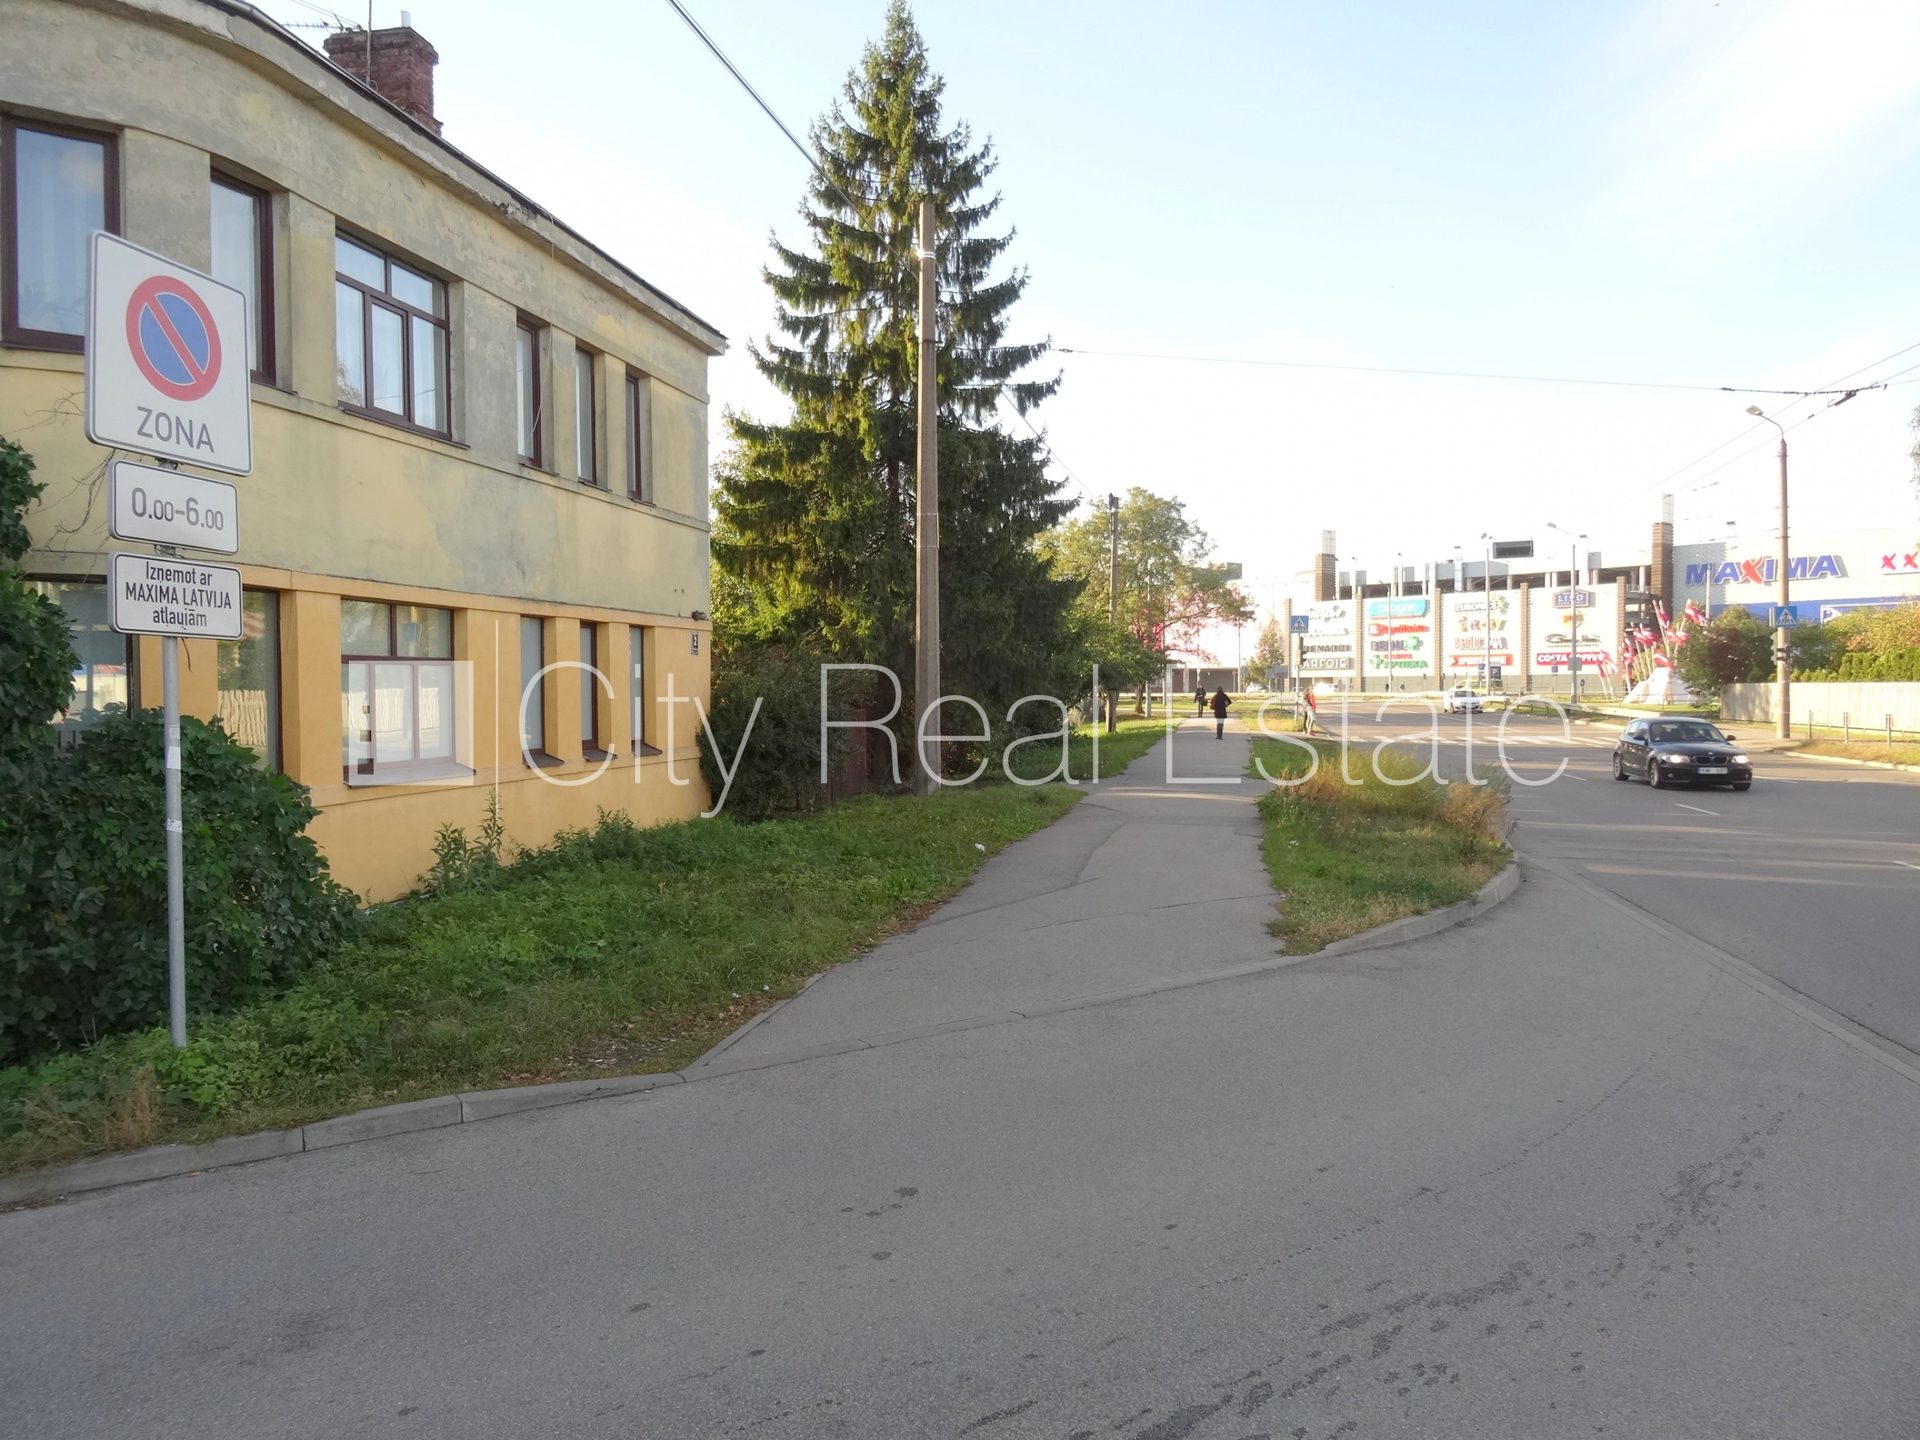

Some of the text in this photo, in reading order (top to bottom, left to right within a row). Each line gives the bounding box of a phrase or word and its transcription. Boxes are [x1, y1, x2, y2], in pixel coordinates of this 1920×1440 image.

[136, 406, 215, 453] ZONA
[145, 561, 213, 586] Izņemot ar
[1685, 554, 1842, 585] MAXIMA
[125, 581, 232, 610] MAXIMA LATVIJA
